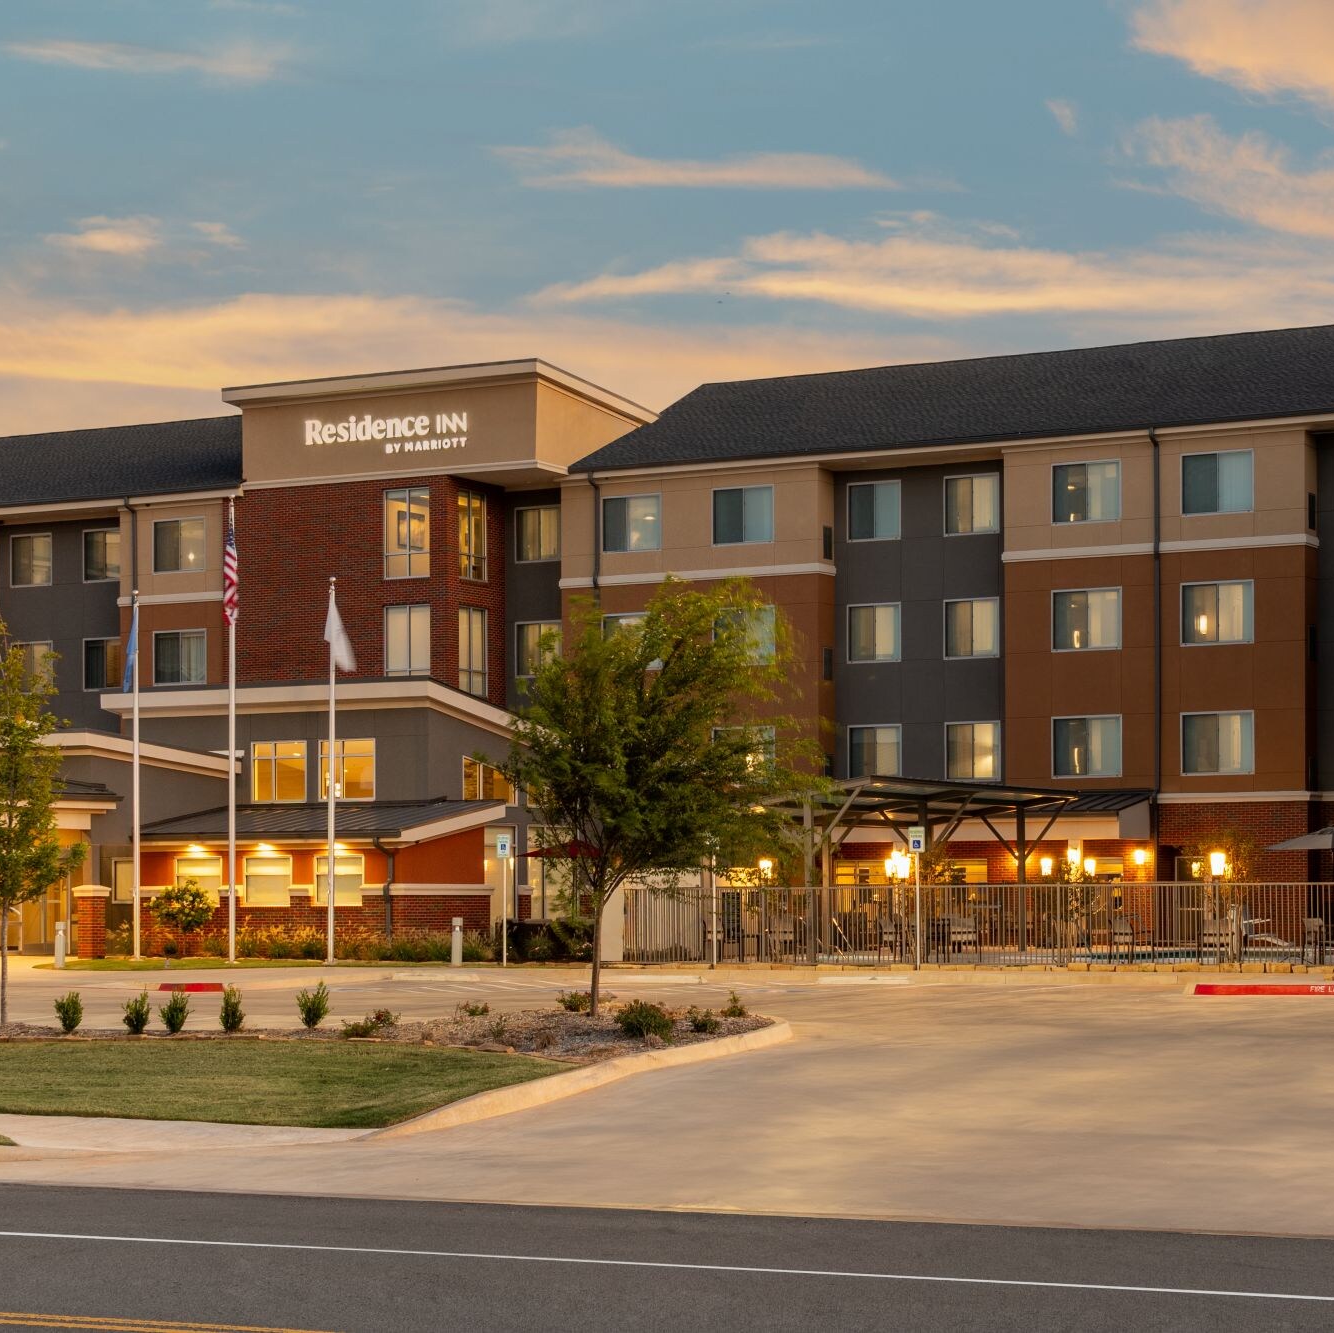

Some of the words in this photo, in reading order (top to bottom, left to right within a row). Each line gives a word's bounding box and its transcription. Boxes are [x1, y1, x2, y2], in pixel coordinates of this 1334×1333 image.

[305, 415, 430, 446] Residence
[436, 412, 468, 435] INN
[385, 442, 402, 454] BY
[404, 437, 468, 453] MARRIOTT
[1309, 985, 1325, 993] FIRE
